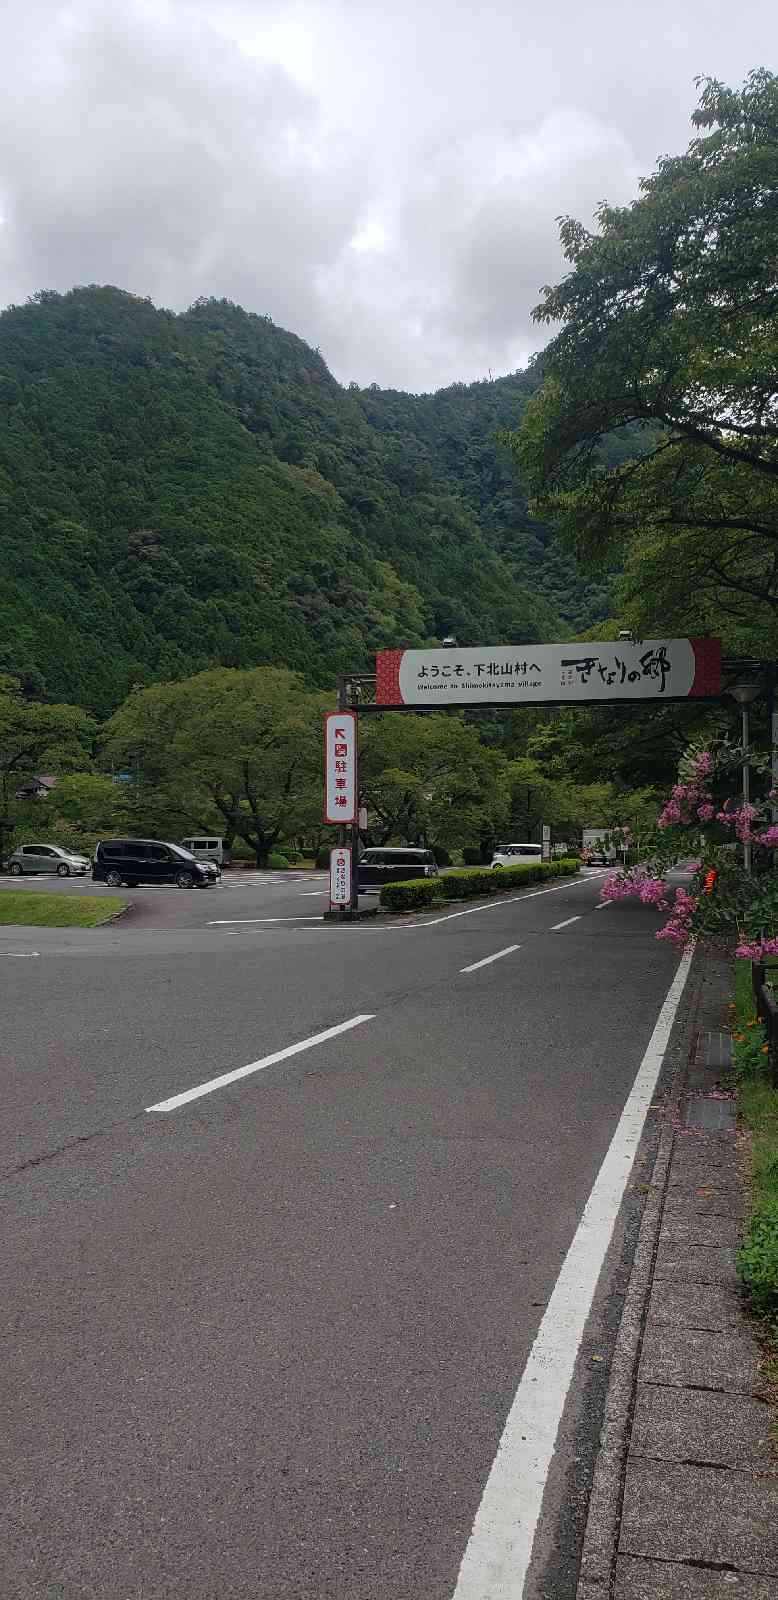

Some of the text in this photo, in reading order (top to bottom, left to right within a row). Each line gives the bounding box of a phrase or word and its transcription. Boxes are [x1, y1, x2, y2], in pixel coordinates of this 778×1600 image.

[417, 661, 542, 678] ようこそ、下北山村へ
[417, 683, 448, 691] Welcome
[518, 680, 543, 689] village
[334, 761, 347, 808] 駐車場
